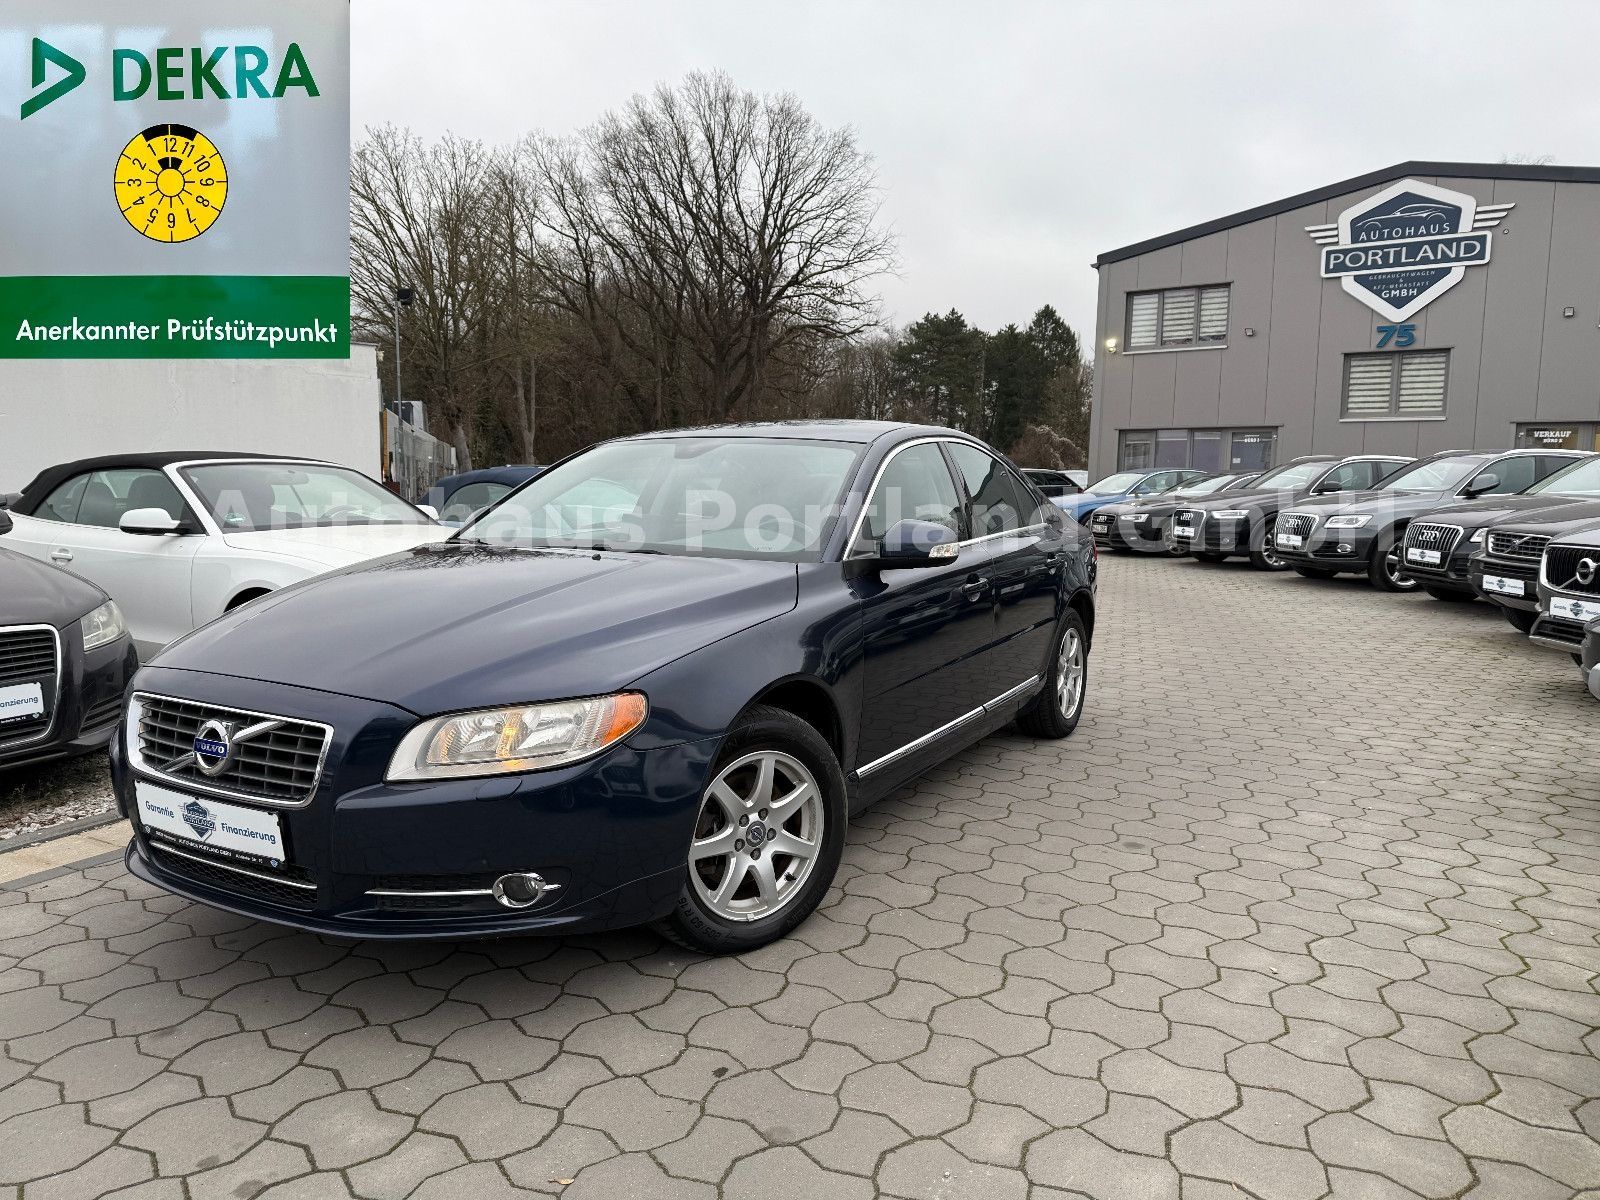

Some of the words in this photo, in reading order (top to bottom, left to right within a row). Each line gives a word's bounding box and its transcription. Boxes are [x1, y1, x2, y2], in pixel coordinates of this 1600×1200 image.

[1359, 222, 1450, 241] AUTOHAUS
[1329, 240, 1481, 269] PORTLAND
[1381, 288, 1418, 298] GMBH
[1376, 324, 1416, 348] 75
[1534, 430, 1571, 438] VERKAUF
[196, 741, 225, 754] VOLVO
[145, 801, 175, 819] Garantie
[221, 822, 277, 845] Finanzierung
